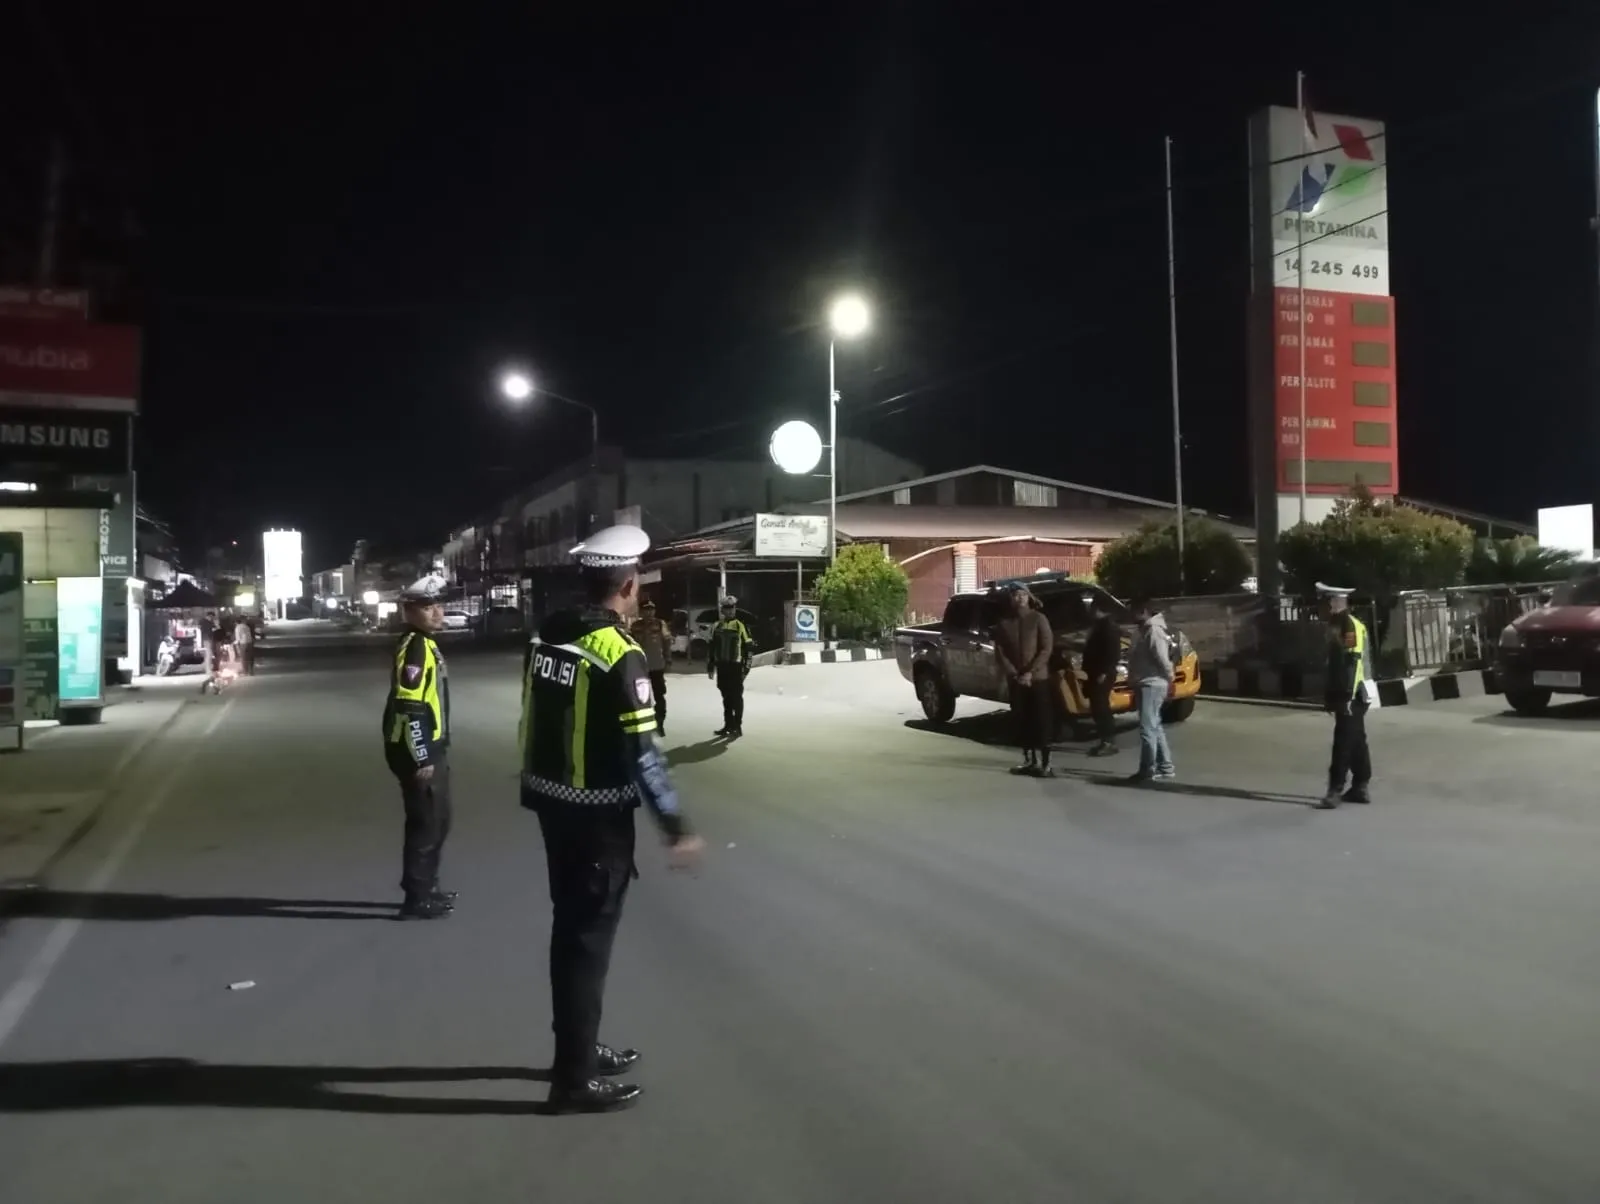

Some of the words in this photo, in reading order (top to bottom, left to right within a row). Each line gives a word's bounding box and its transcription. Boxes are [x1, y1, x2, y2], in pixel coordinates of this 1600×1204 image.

[1284, 218, 1378, 240] PERTAMINA
[1311, 260, 1343, 276] 245
[1352, 264, 1379, 279] 499
[533, 653, 577, 687] POLISI
[409, 719, 429, 762] POLISI
